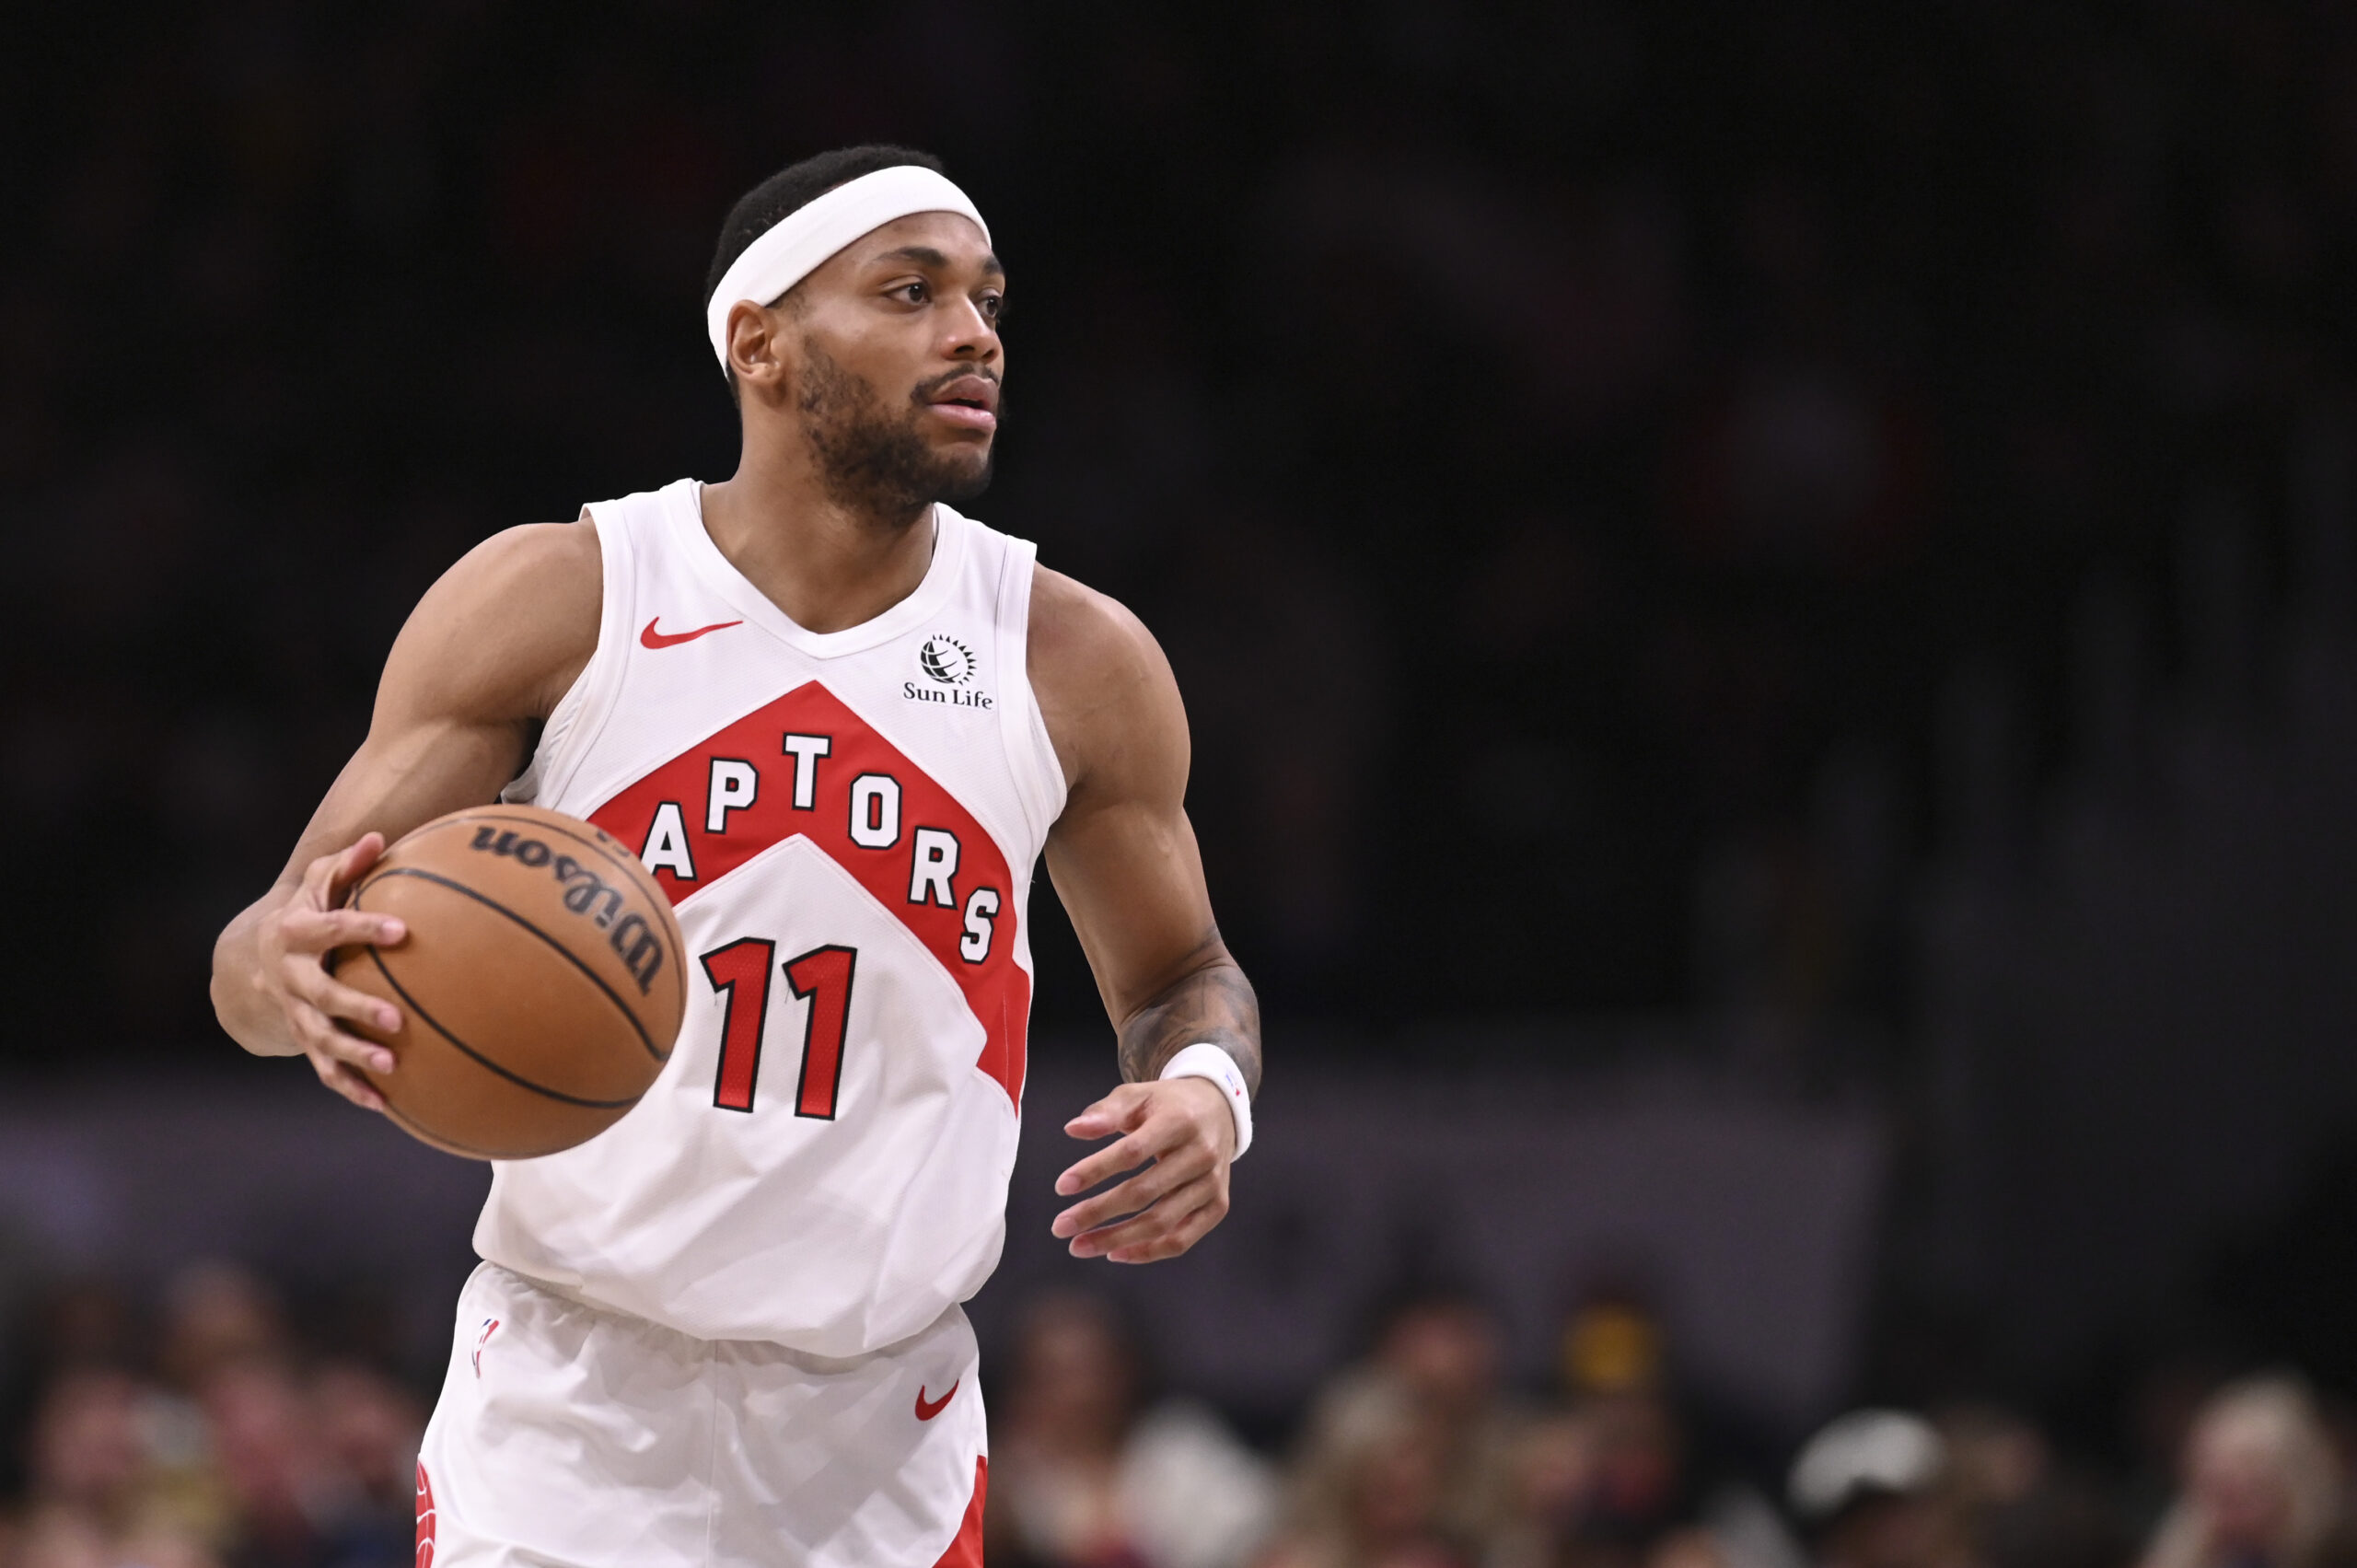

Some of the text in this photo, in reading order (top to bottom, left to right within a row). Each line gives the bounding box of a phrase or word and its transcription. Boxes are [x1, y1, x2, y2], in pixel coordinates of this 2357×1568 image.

[903, 681, 993, 710] Sun Life
[470, 825, 664, 997] Wilson
[640, 732, 1001, 965] APTORS
[699, 936, 858, 1121] 11
